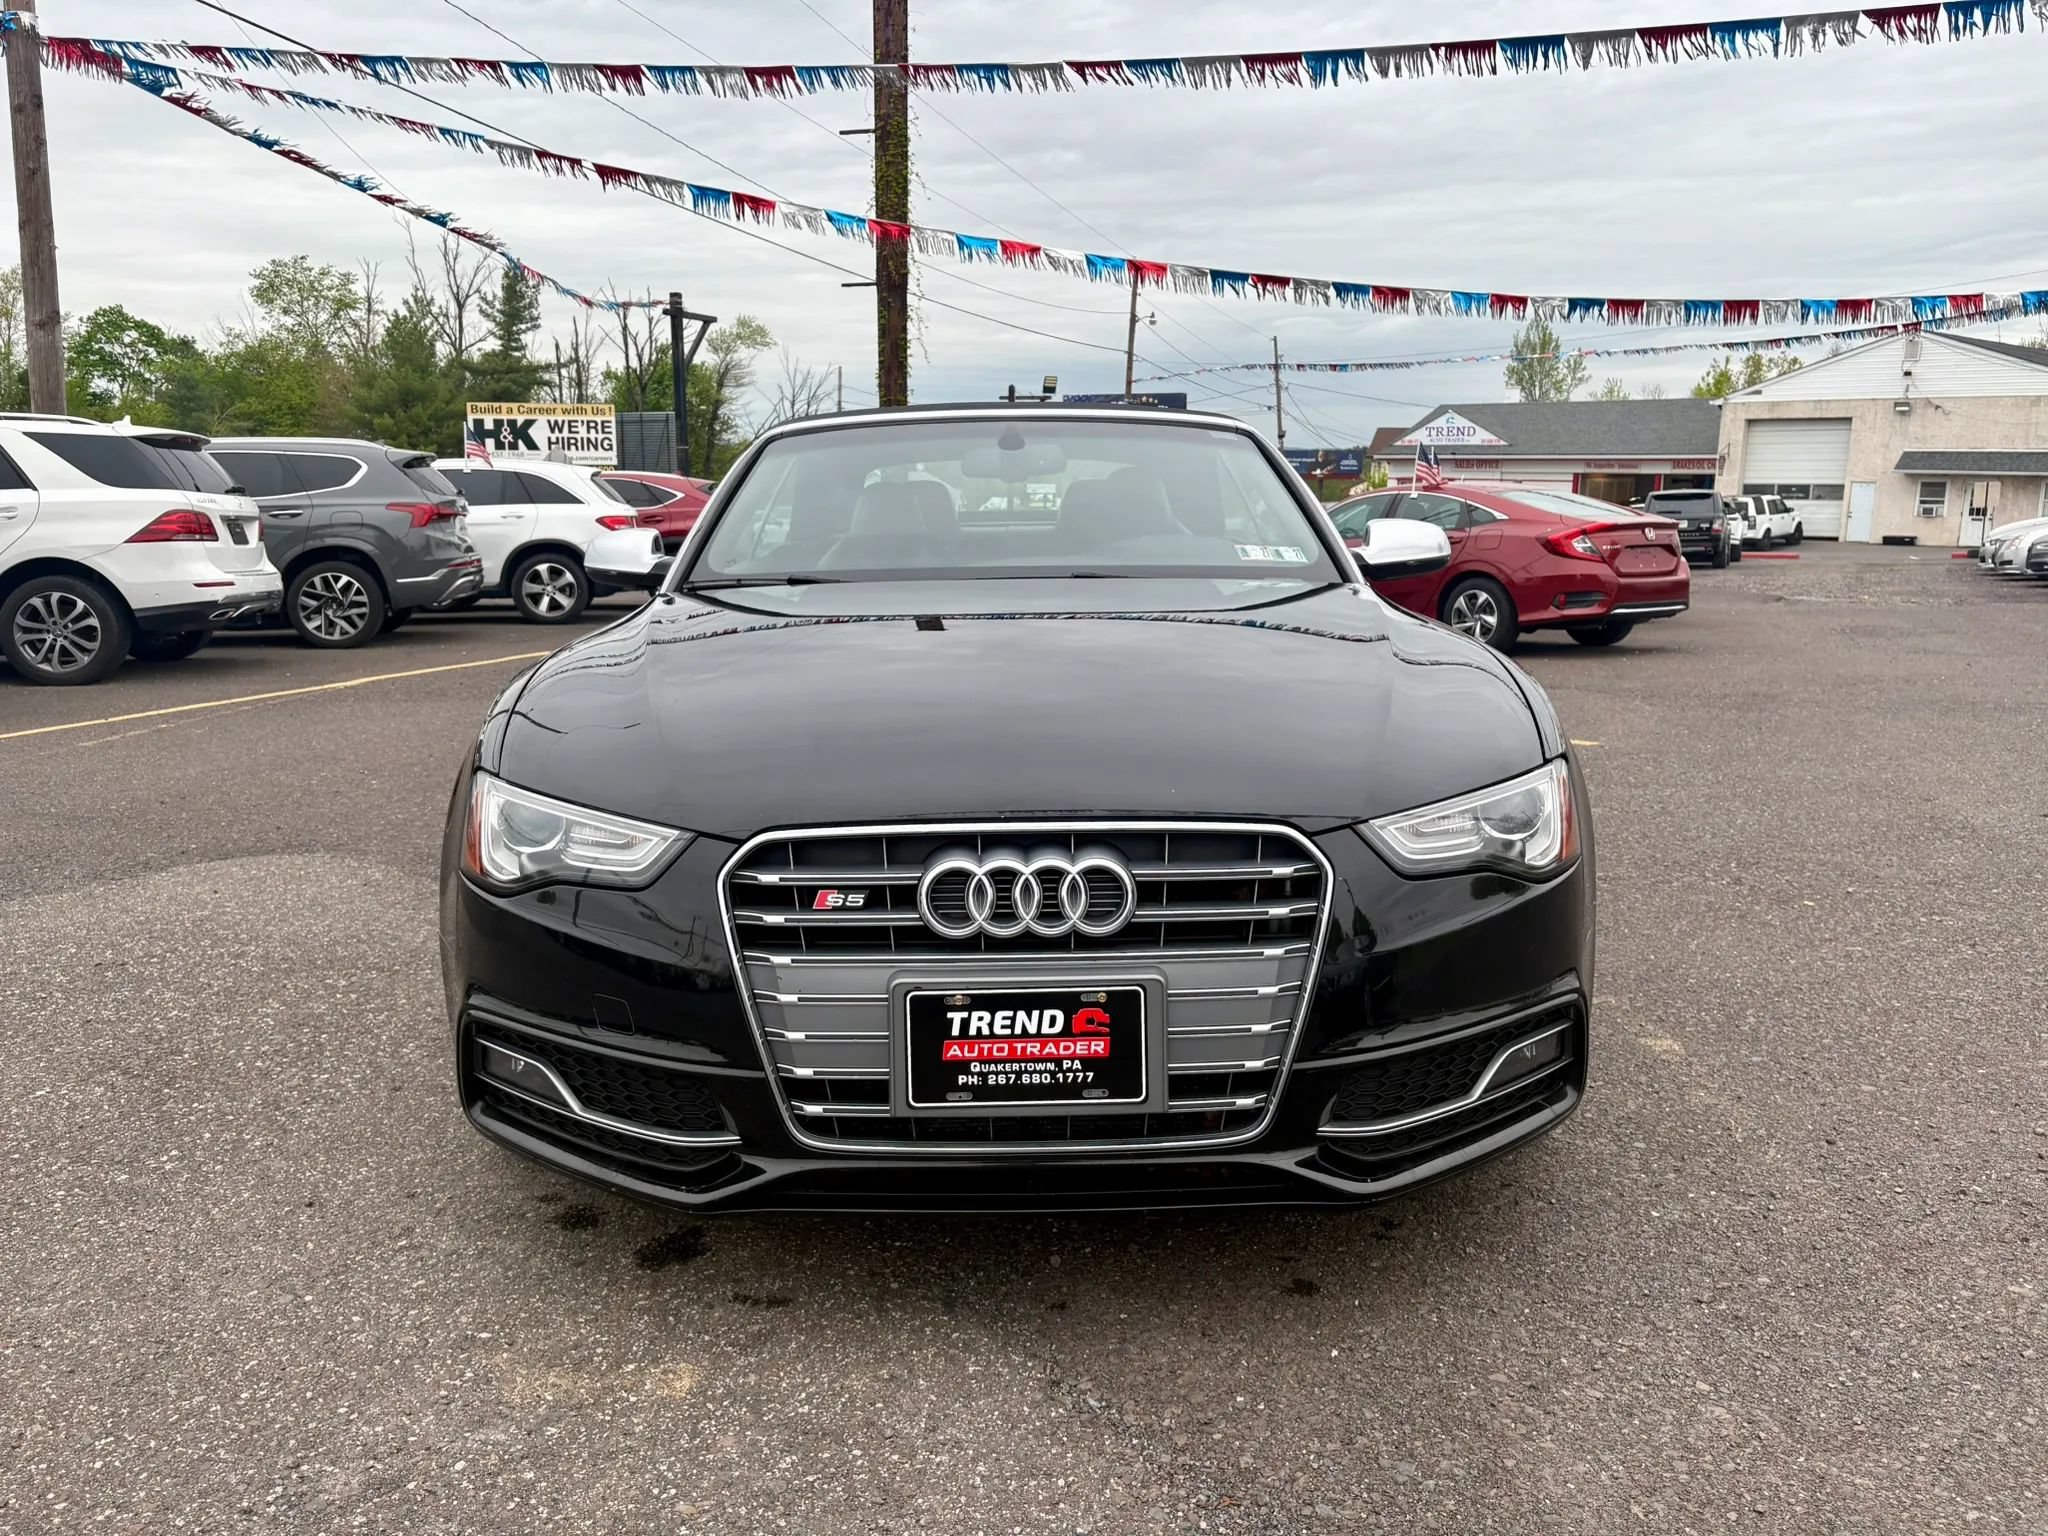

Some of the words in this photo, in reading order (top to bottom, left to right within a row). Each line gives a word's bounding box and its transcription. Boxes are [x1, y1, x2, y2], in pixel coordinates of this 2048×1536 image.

[470, 404, 502, 415] Build
[506, 406, 513, 414] a
[517, 405, 557, 415] Career
[561, 405, 588, 415] with
[472, 418, 541, 451] H&K
[1425, 426, 1477, 437] TREND
[547, 436, 613, 452] HIRING
[1475, 460, 1500, 469] OFFICE
[825, 894, 865, 906] S5
[946, 1009, 1065, 1036] TREND
[946, 1043, 1009, 1057] AUTO
[1013, 1041, 1105, 1056] TRADER
[1062, 1060, 1082, 1070] PA
[958, 1075, 983, 1086] PH:
[987, 1072, 1095, 1084] 267.680.1777
